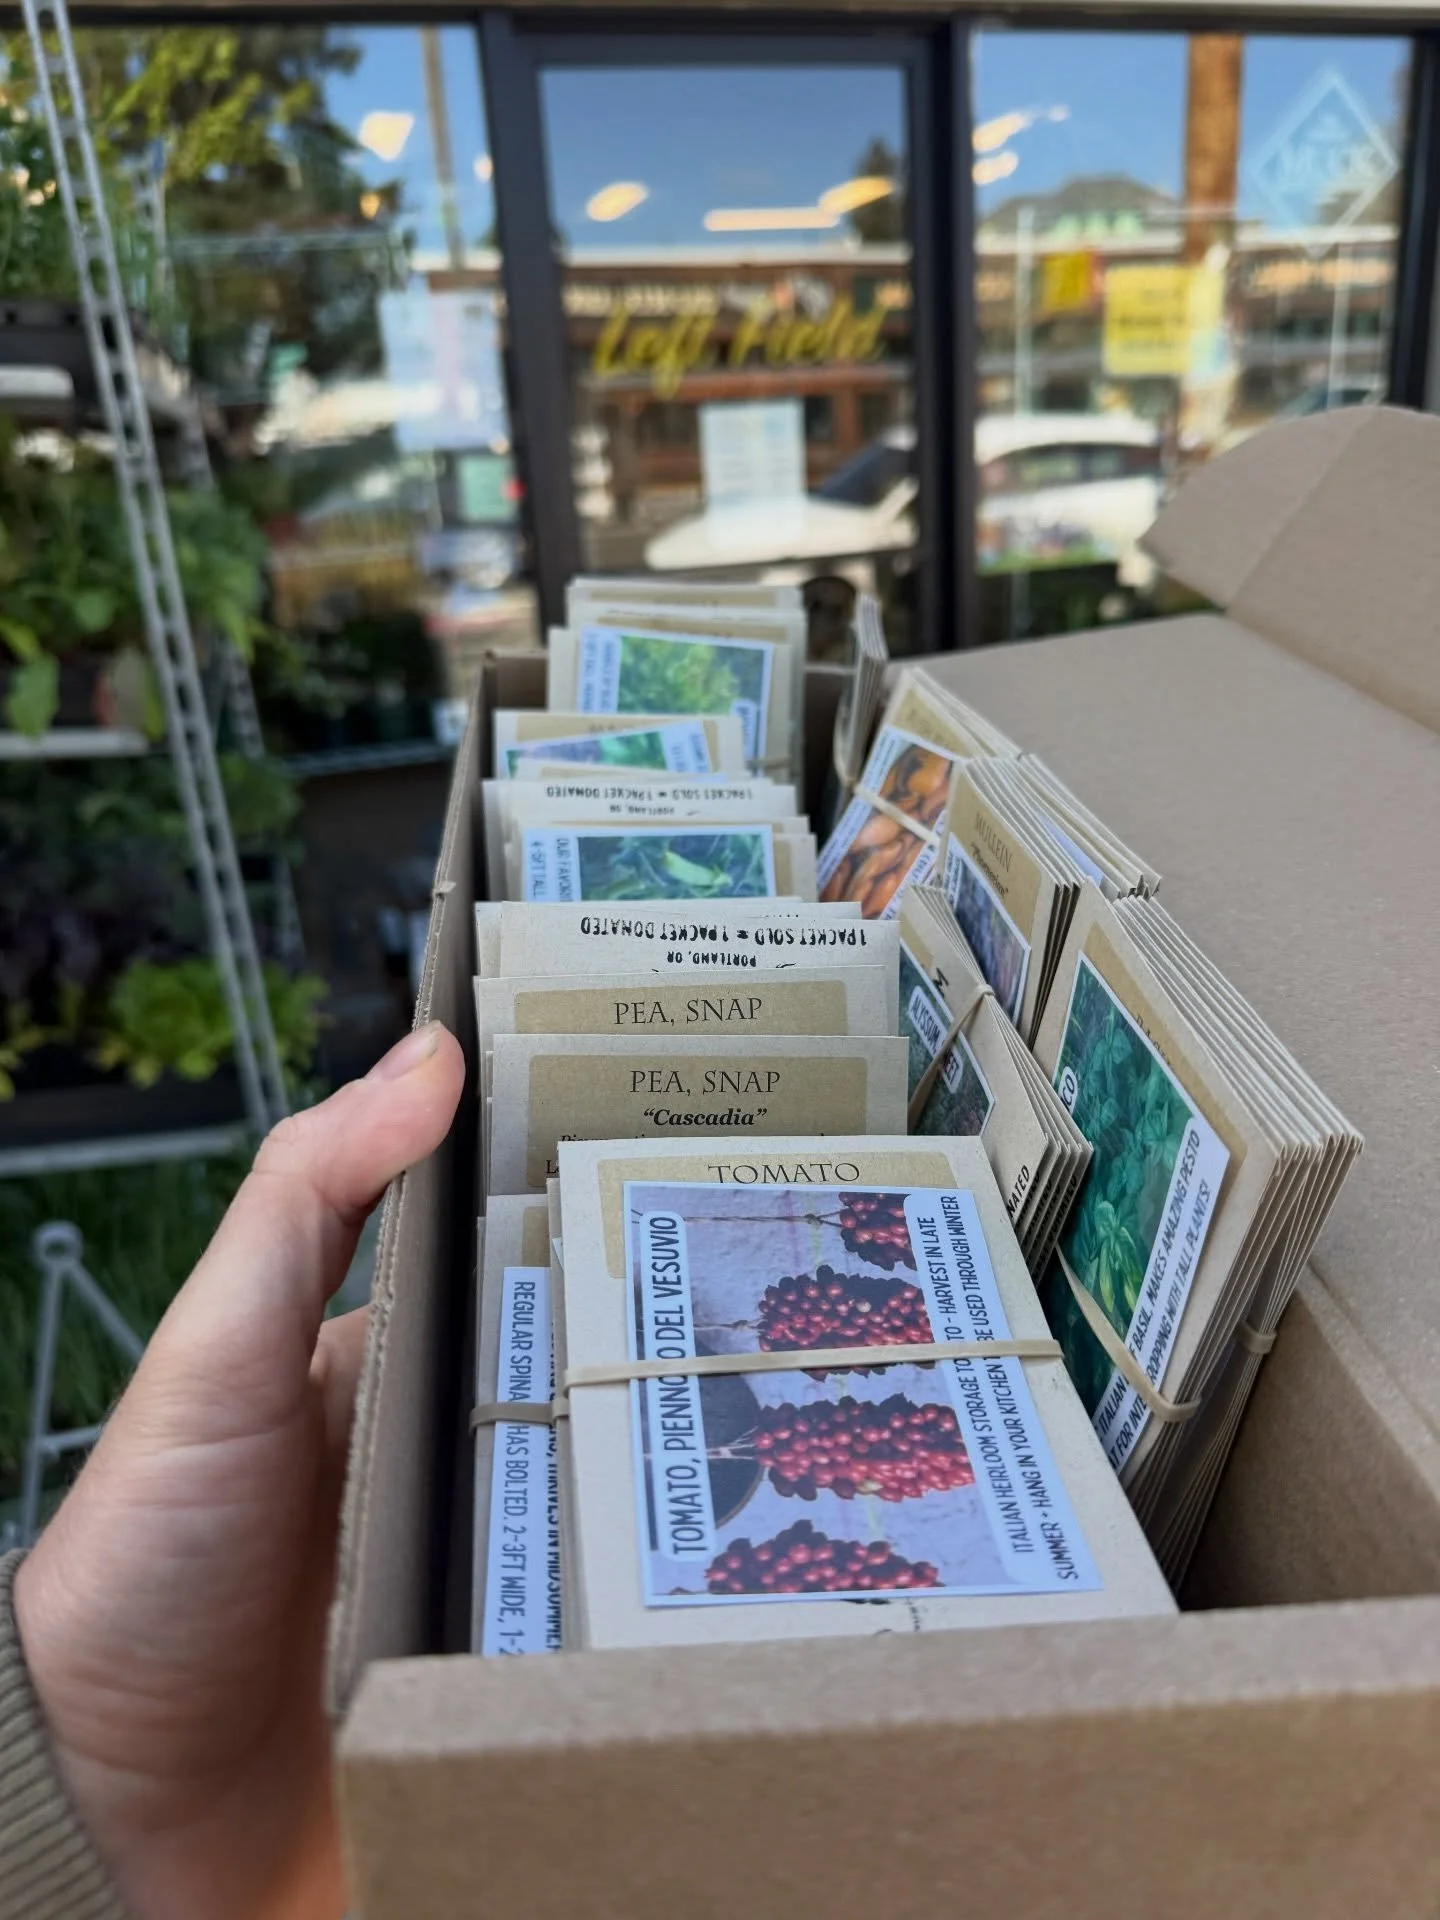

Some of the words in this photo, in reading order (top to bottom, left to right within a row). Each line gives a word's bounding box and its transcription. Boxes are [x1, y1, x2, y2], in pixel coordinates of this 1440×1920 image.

[580, 916, 655, 940] DONATED
[660, 921, 718, 943] PACKET
[754, 928, 794, 947] SOLD
[800, 928, 858, 947] PACKET
[667, 950, 682, 964] OR
[687, 950, 757, 968] PORTLAND,
[613, 1001, 676, 1027] PEA,
[686, 997, 763, 1023] SNAP
[629, 1069, 692, 1097] PEA,
[701, 1070, 782, 1095] SNAP
[707, 1161, 861, 1185] TOMATO
[1006, 1164, 1030, 1219] NATED
[917, 1217, 940, 1244] LATE
[940, 1195, 966, 1237] WINTER
[649, 1216, 683, 1299] VESUVIO
[924, 1246, 944, 1259] IN
[951, 1238, 981, 1291] THROUGH
[927, 1260, 958, 1315] HARVEST
[1098, 1376, 1127, 1435] ITALIAN
[1146, 1249, 1168, 1306] MAKES
[1161, 1179, 1188, 1257] AMAZING
[1181, 1129, 1201, 1188] PESTO
[511, 1281, 536, 1351] REGULAR
[653, 1304, 686, 1341] DEL
[965, 1294, 990, 1327] USED
[944, 1326, 976, 1374] TOTO
[1115, 1421, 1134, 1457] FOR
[1164, 1280, 1182, 1323] WITH
[1175, 1249, 1193, 1287] TALL
[507, 1354, 533, 1404] SPINA
[656, 1346, 698, 1451] PIENNOO
[986, 1363, 1020, 1416] KITCHEN
[959, 1375, 993, 1433] STORAGE
[505, 1423, 530, 1456] HAS
[1003, 1418, 1032, 1454] YOUR
[976, 1435, 1016, 1499] HEIRLOOM
[1016, 1454, 1039, 1470] IN
[502, 1460, 530, 1521] BOLTED.
[665, 1458, 709, 1556] TOMATO,
[1024, 1470, 1053, 1509] HANG
[500, 1525, 528, 1572] 2-3FT
[1001, 1500, 1035, 1554] ITALIAN
[1040, 1522, 1079, 1582] SUMMER
[496, 1576, 526, 1623] WIDE,
